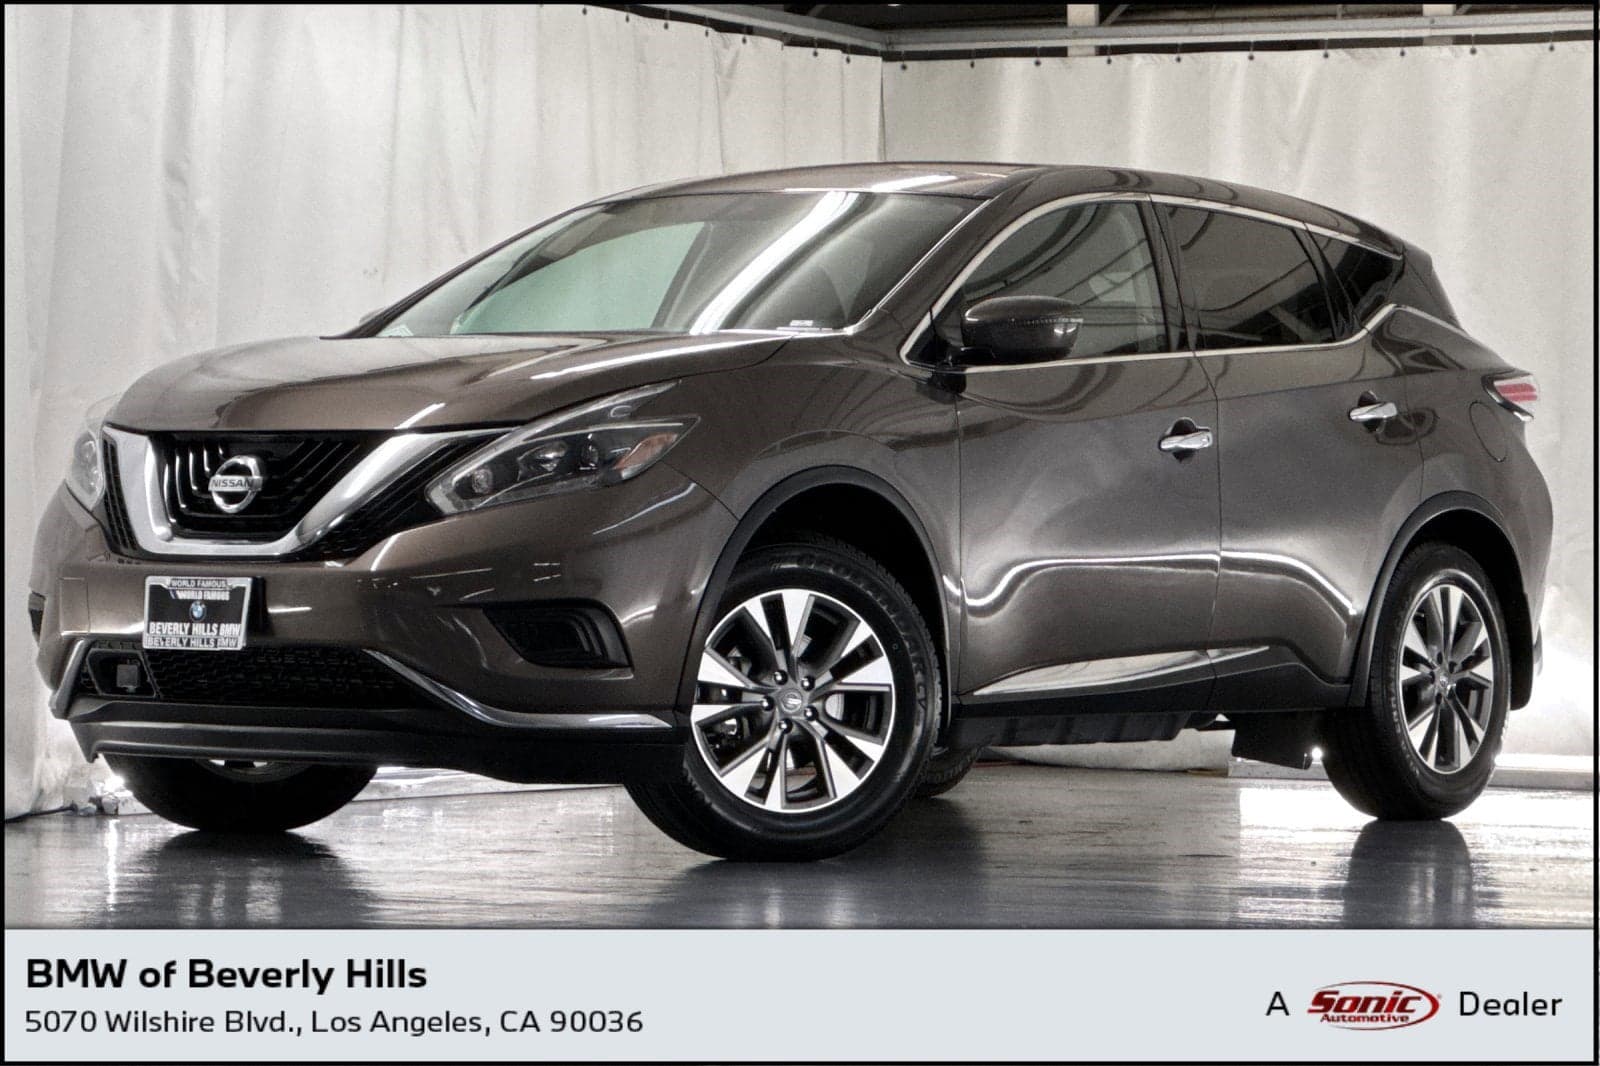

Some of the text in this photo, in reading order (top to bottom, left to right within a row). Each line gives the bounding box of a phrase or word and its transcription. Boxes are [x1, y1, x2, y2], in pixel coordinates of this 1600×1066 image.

[212, 479, 251, 488] NISSAN
[171, 580, 227, 588] WORLD FAMOUS
[149, 622, 241, 637] BEVERLY HILLS BMW
[147, 636, 237, 648] BEVERLY HILLS BMW
